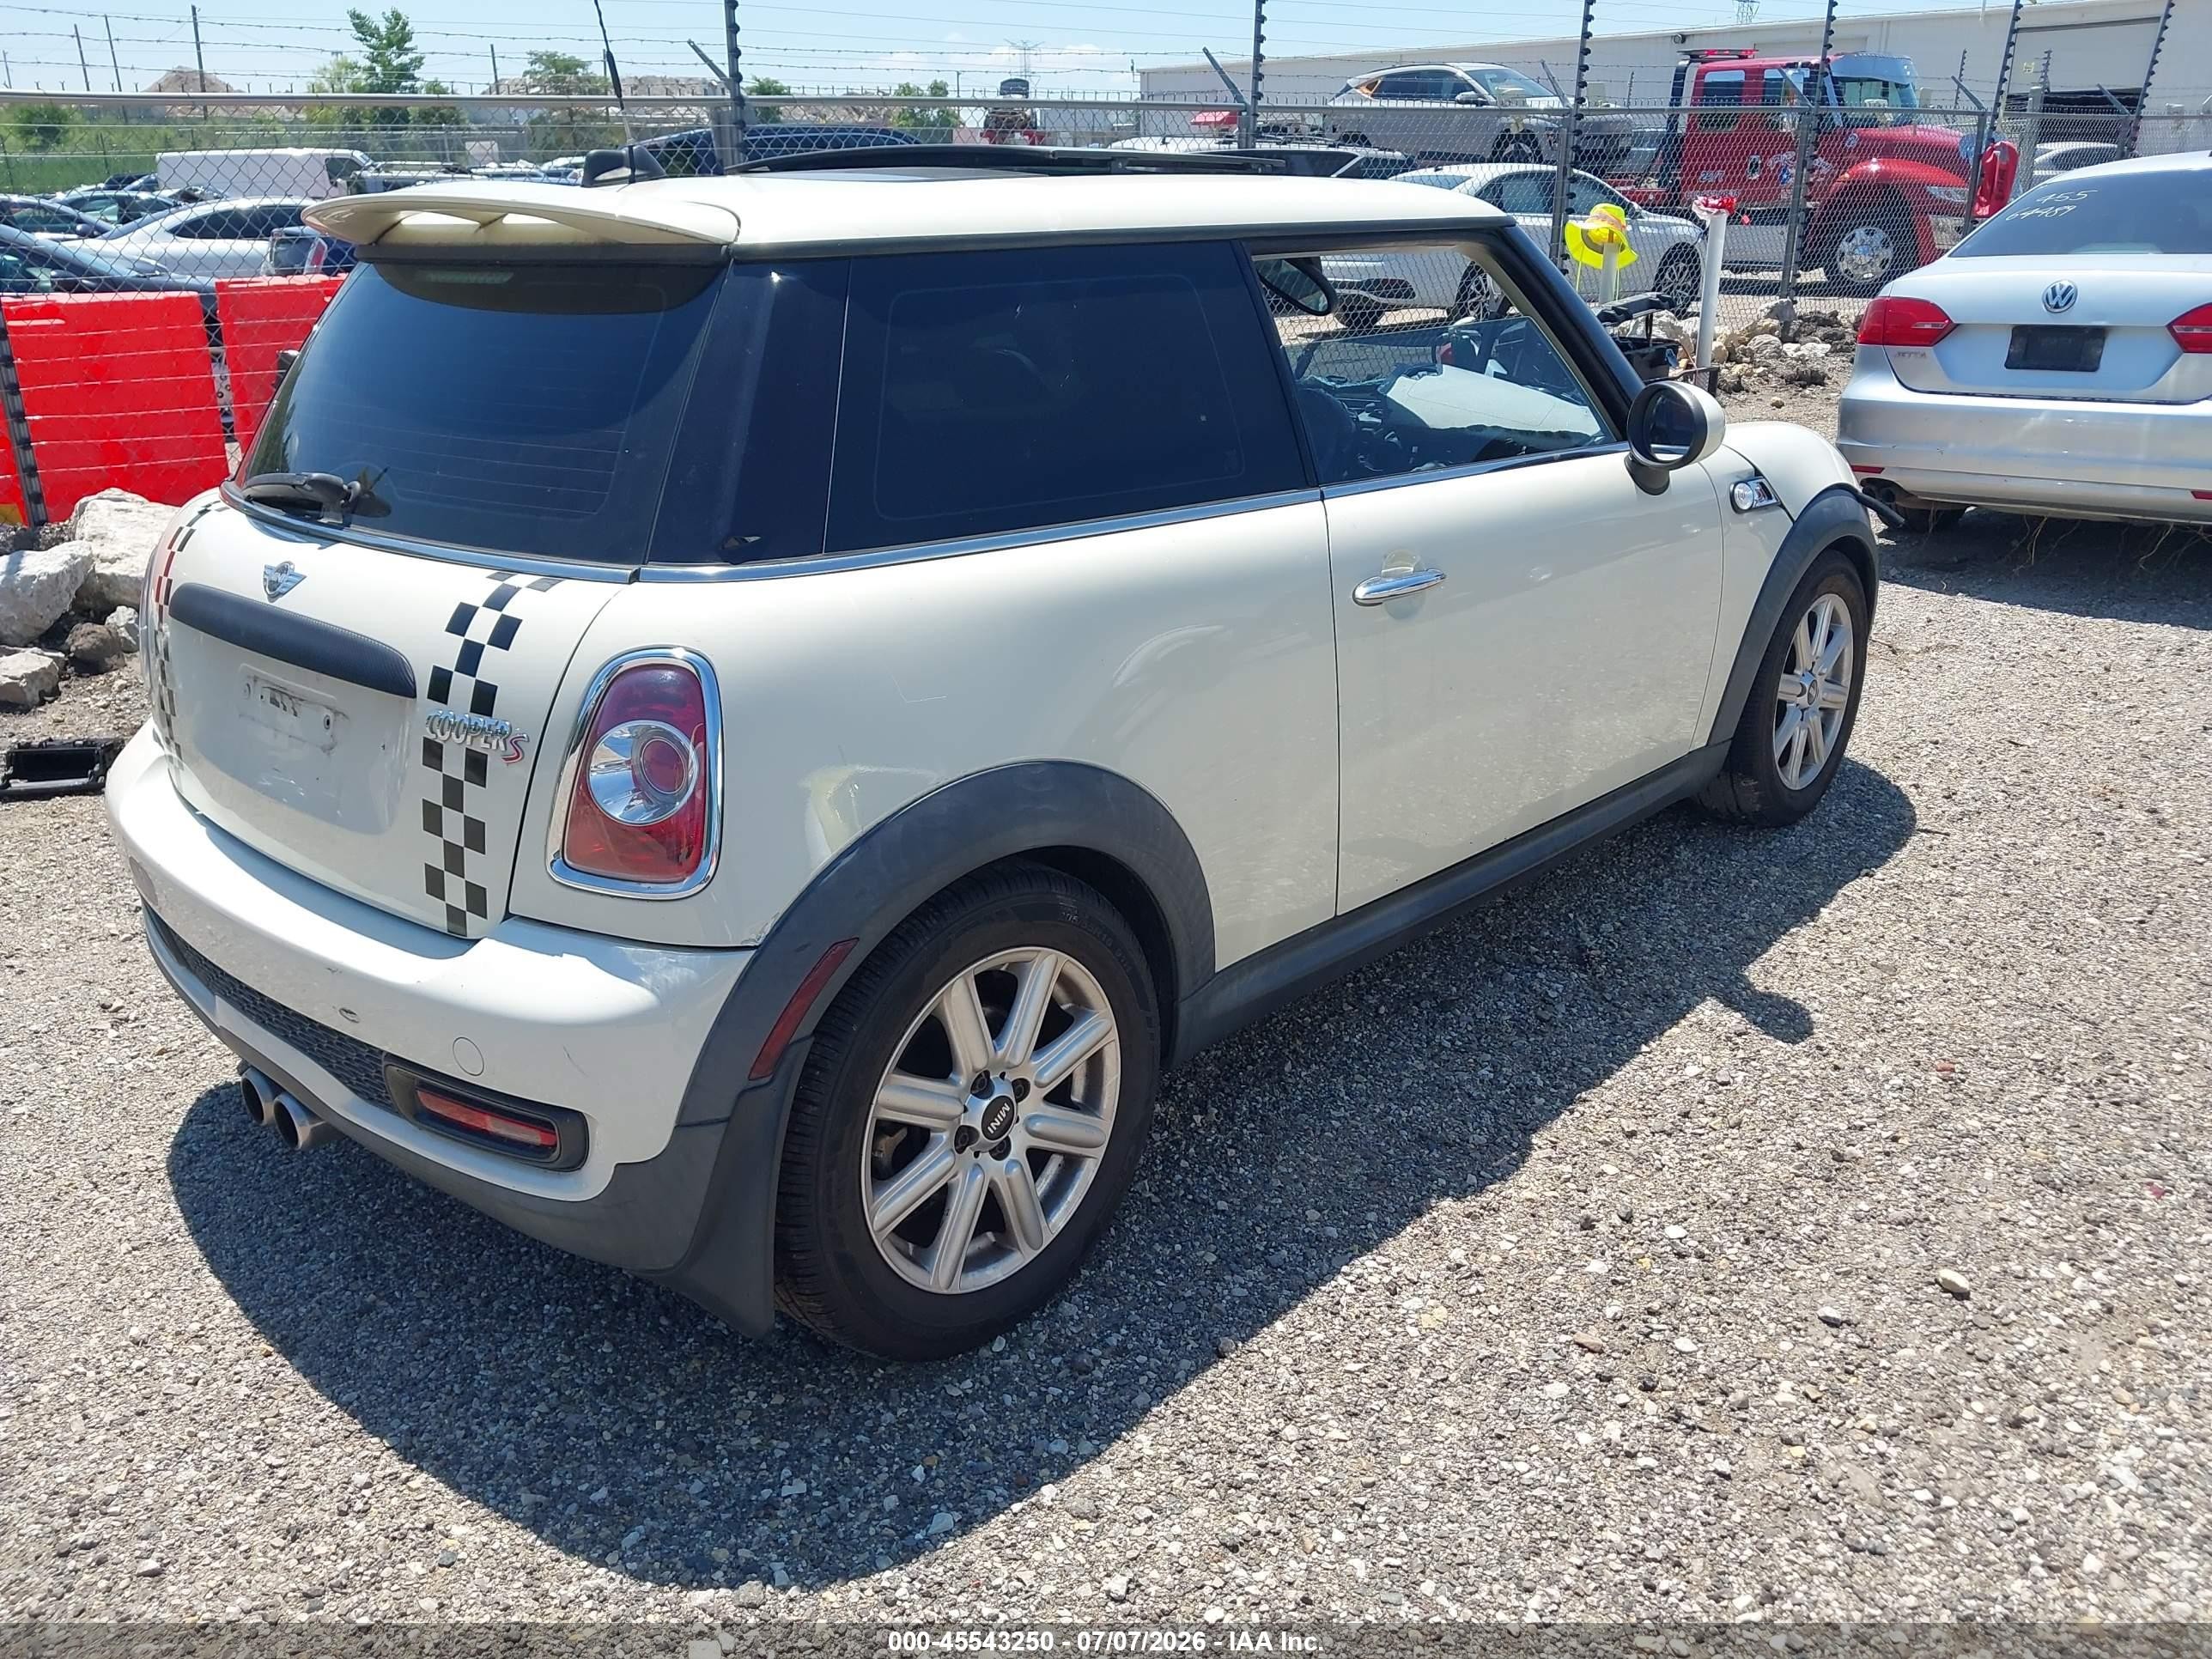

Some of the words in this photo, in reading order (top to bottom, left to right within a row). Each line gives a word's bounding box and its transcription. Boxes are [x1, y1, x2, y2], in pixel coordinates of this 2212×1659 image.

[2036, 188, 2099, 204] 455
[426, 709, 513, 751] COOPER
[501, 732, 530, 763] S
[987, 1102, 1011, 1134] MINI
